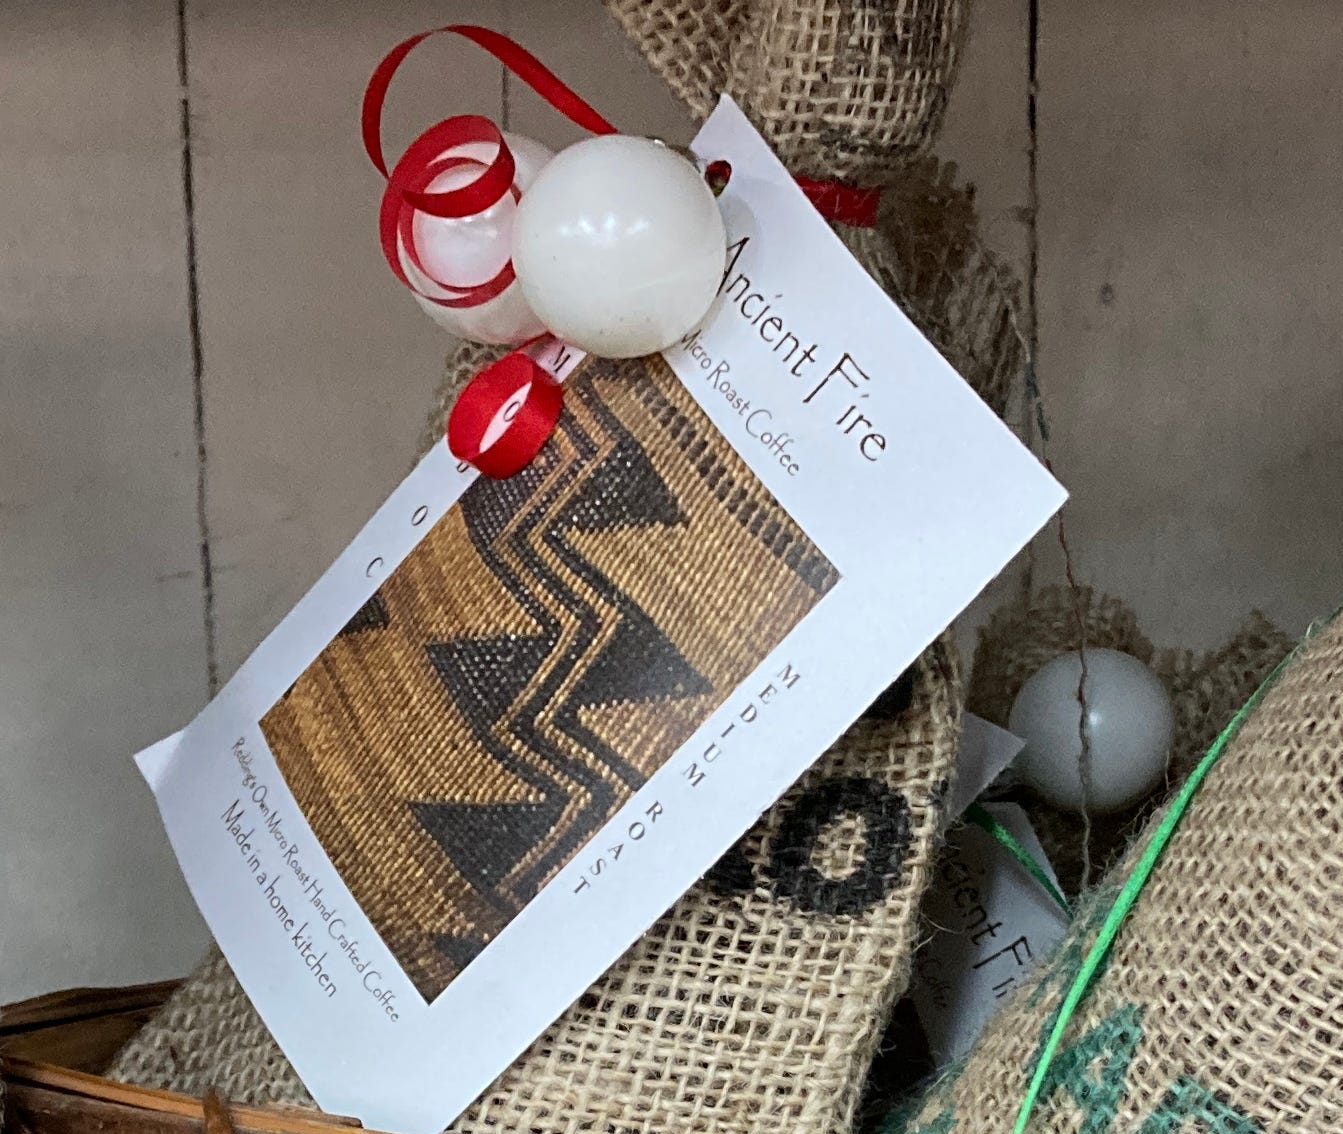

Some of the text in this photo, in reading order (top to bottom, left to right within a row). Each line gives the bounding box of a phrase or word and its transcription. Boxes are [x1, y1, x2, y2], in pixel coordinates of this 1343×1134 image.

[681, 328, 800, 477] Micro Roast Coffee
[803, 352, 887, 462] Fire
[682, 663, 801, 789] MEDIUM
[220, 799, 338, 999] Made in a home kitchen
[251, 785, 270, 819] Own
[264, 810, 288, 850] Micro
[282, 843, 311, 887] Roast
[304, 879, 336, 923] Hand
[328, 918, 372, 973] Crafted
[362, 970, 399, 1023] Coffee
[573, 801, 664, 895] ROAST
